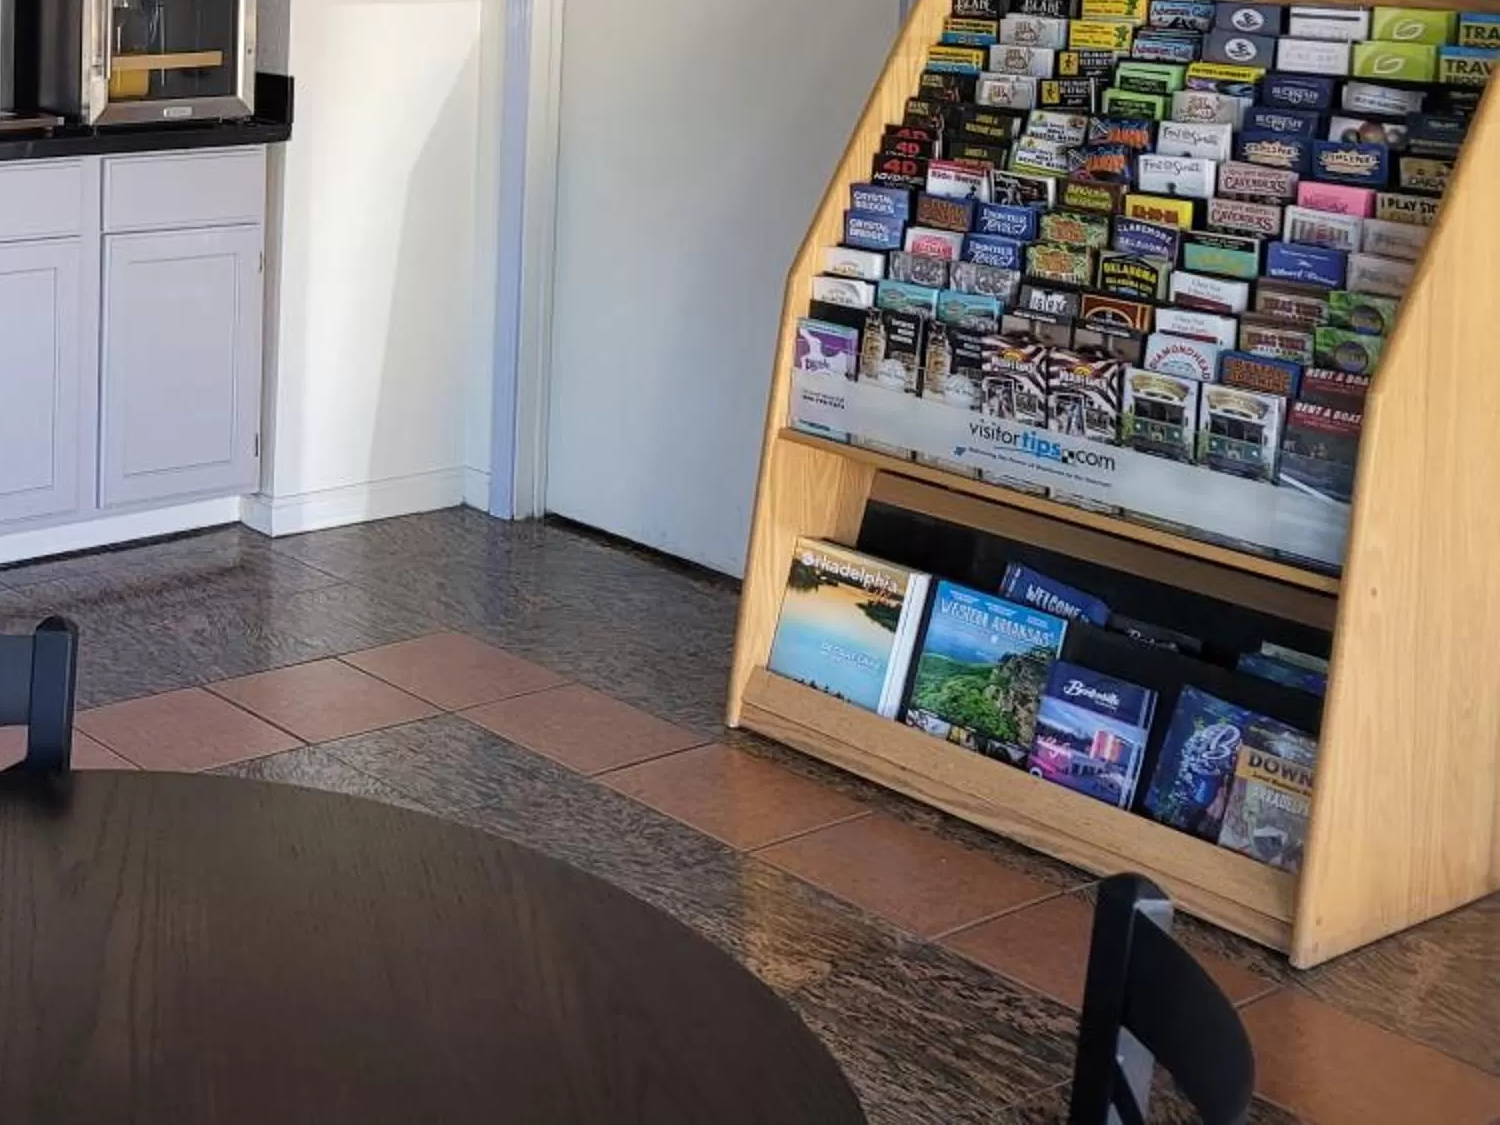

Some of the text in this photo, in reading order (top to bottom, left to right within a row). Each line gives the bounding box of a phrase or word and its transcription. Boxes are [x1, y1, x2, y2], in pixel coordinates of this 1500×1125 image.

[883, 158, 917, 176] 4D
[1387, 198, 1416, 212] PLAY
[1306, 368, 1333, 381] RENT
[1293, 402, 1362, 422] RENT A BOAT
[1026, 583, 1081, 619] WELCOME
